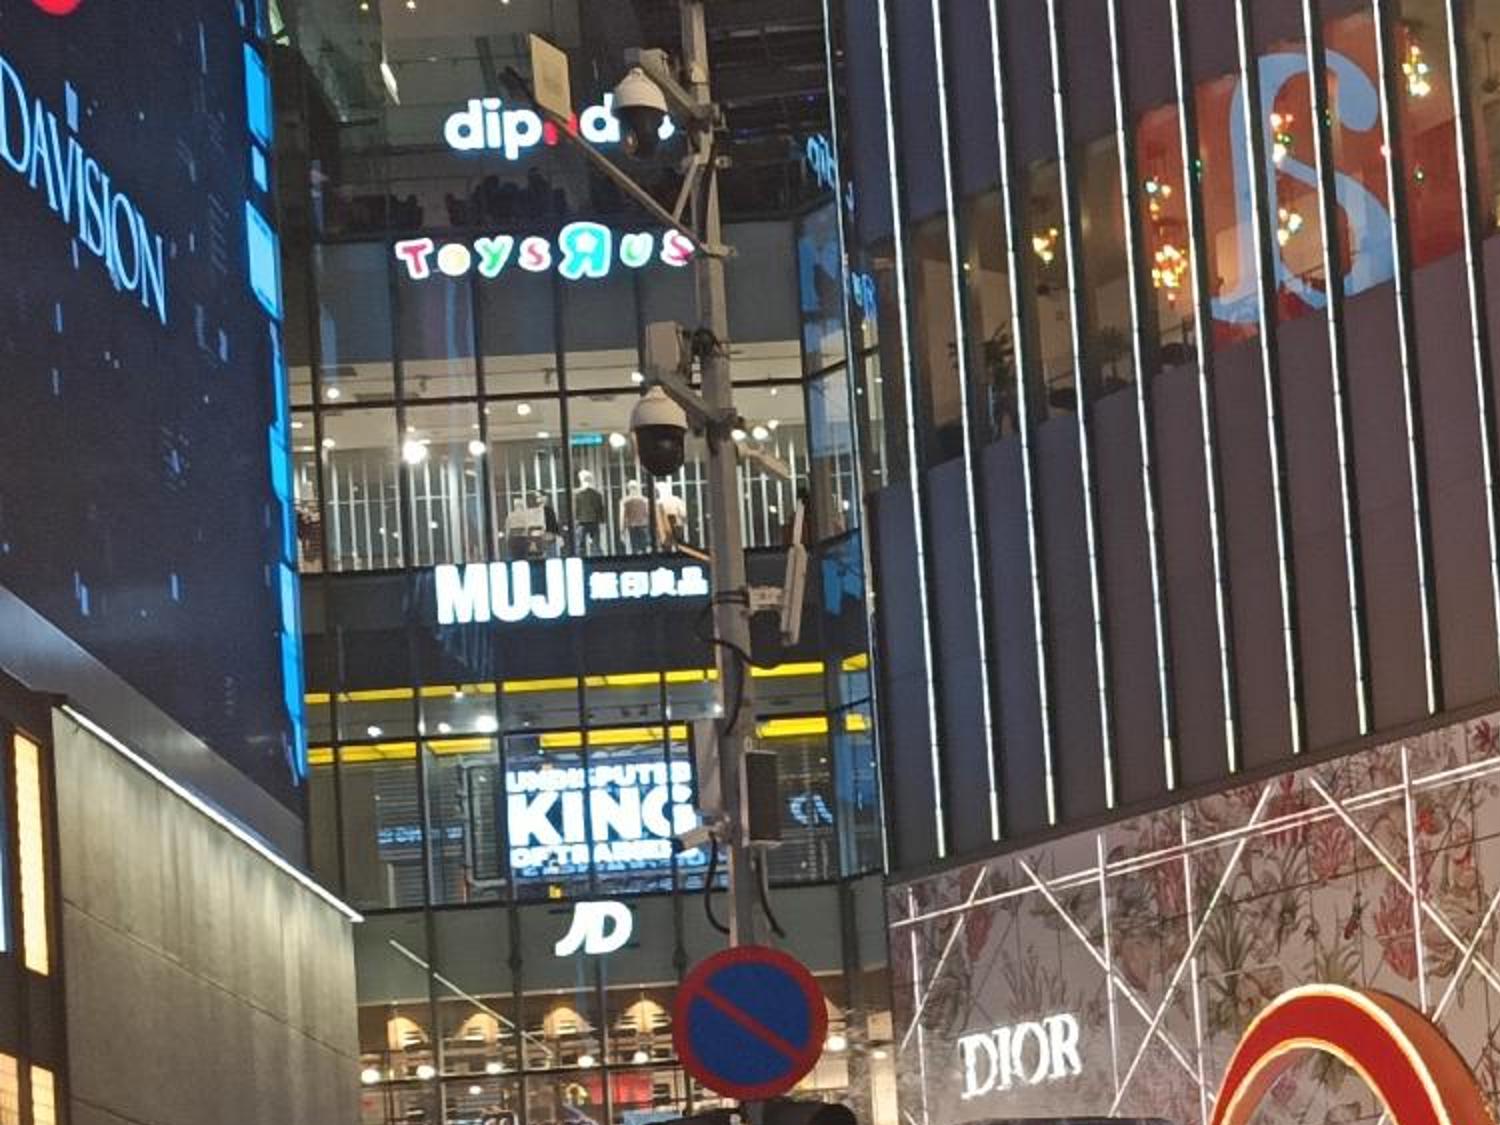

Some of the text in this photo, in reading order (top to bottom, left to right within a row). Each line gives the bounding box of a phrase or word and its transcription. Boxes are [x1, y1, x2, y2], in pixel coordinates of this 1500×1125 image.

[435, 557, 586, 625] MUJI
[507, 784, 699, 847] KING
[555, 900, 633, 956] JD
[958, 1013, 1082, 1099] DIOR
